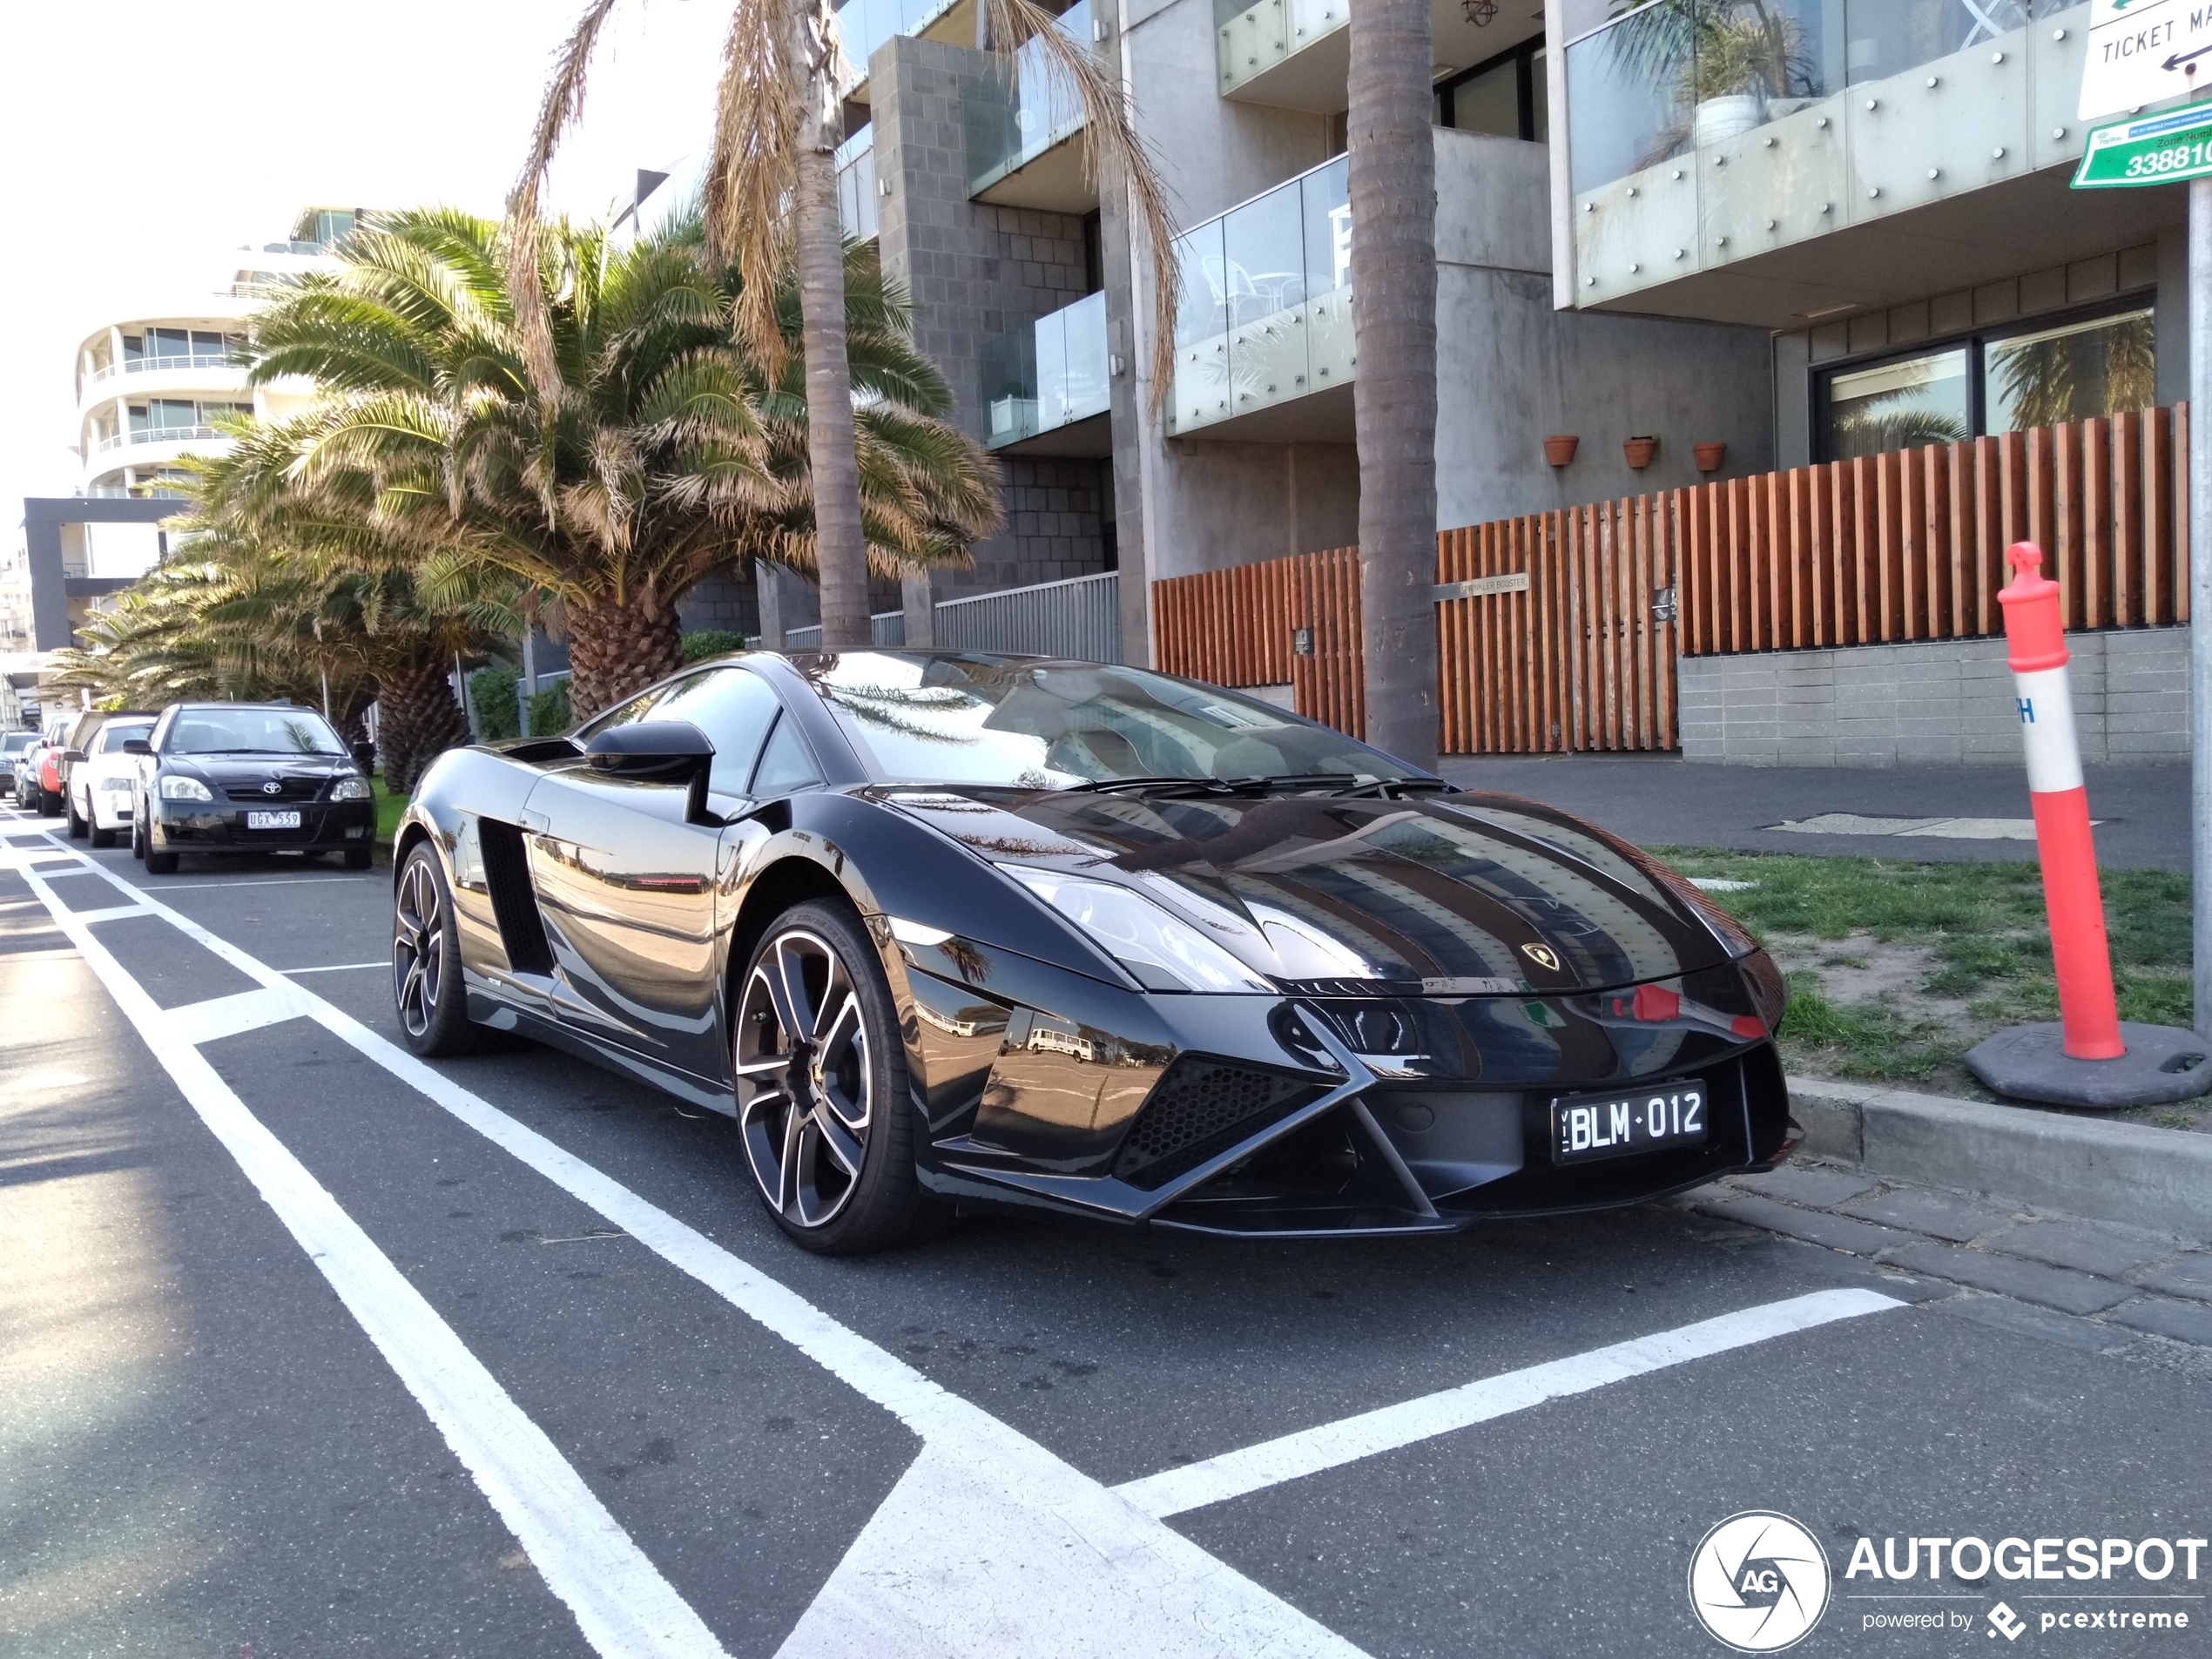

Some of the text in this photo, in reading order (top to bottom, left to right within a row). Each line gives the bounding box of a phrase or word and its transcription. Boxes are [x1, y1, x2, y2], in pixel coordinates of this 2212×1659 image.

[2103, 20, 2175, 63] TICKET
[2157, 136, 2182, 148] Zone
[1460, 581, 1494, 592] SPRINKLER
[250, 813, 298, 825] UGX 559
